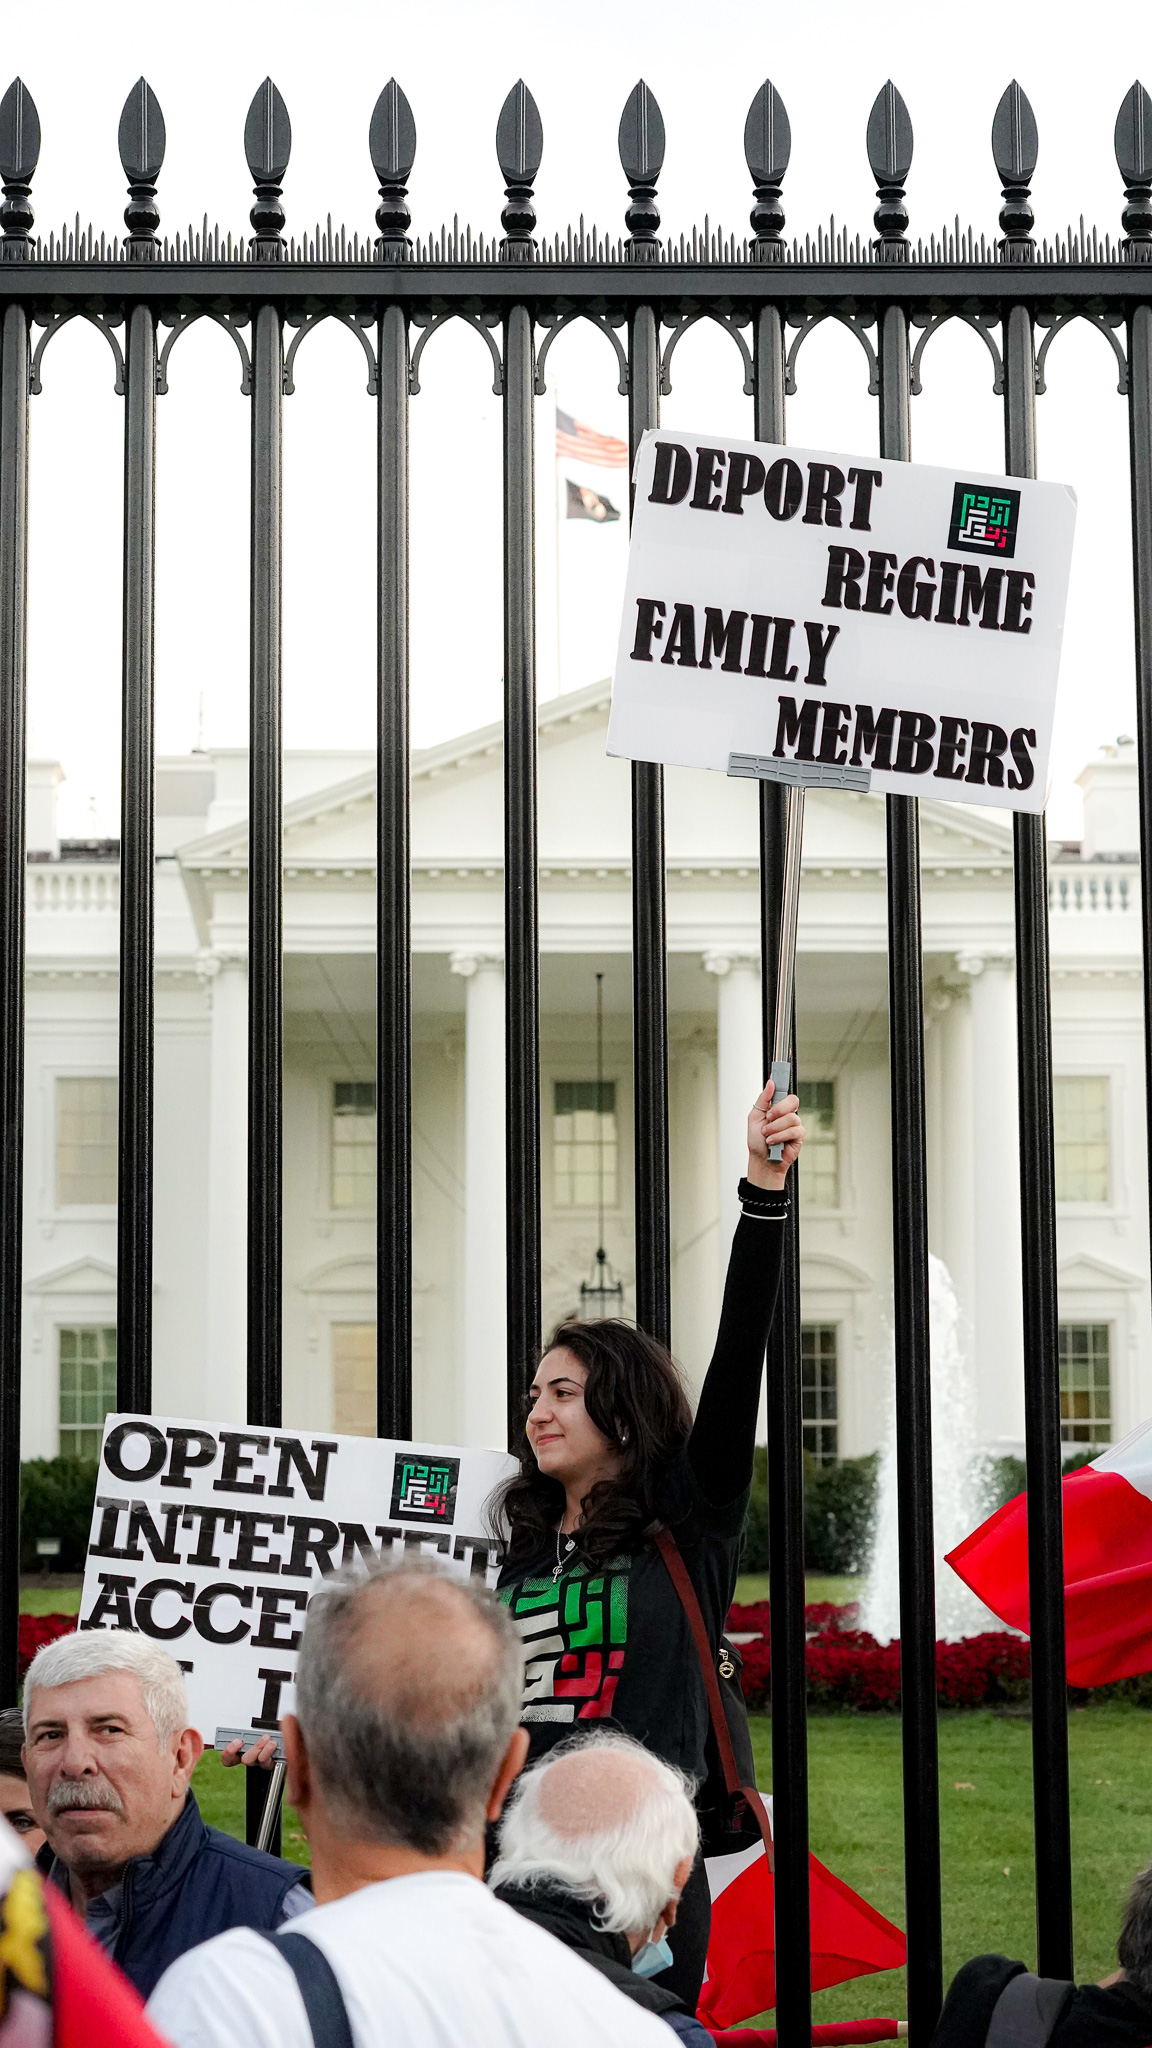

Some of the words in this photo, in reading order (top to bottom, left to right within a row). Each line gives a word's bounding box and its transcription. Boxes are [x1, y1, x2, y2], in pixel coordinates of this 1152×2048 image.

[647, 441, 882, 532] DEPORT
[821, 544, 1036, 635] REGIME
[629, 597, 840, 687] FAMILY
[772, 695, 1037, 791] MEMBERS
[103, 1421, 338, 1502] OPEN
[80, 1572, 316, 1651] ACCE
